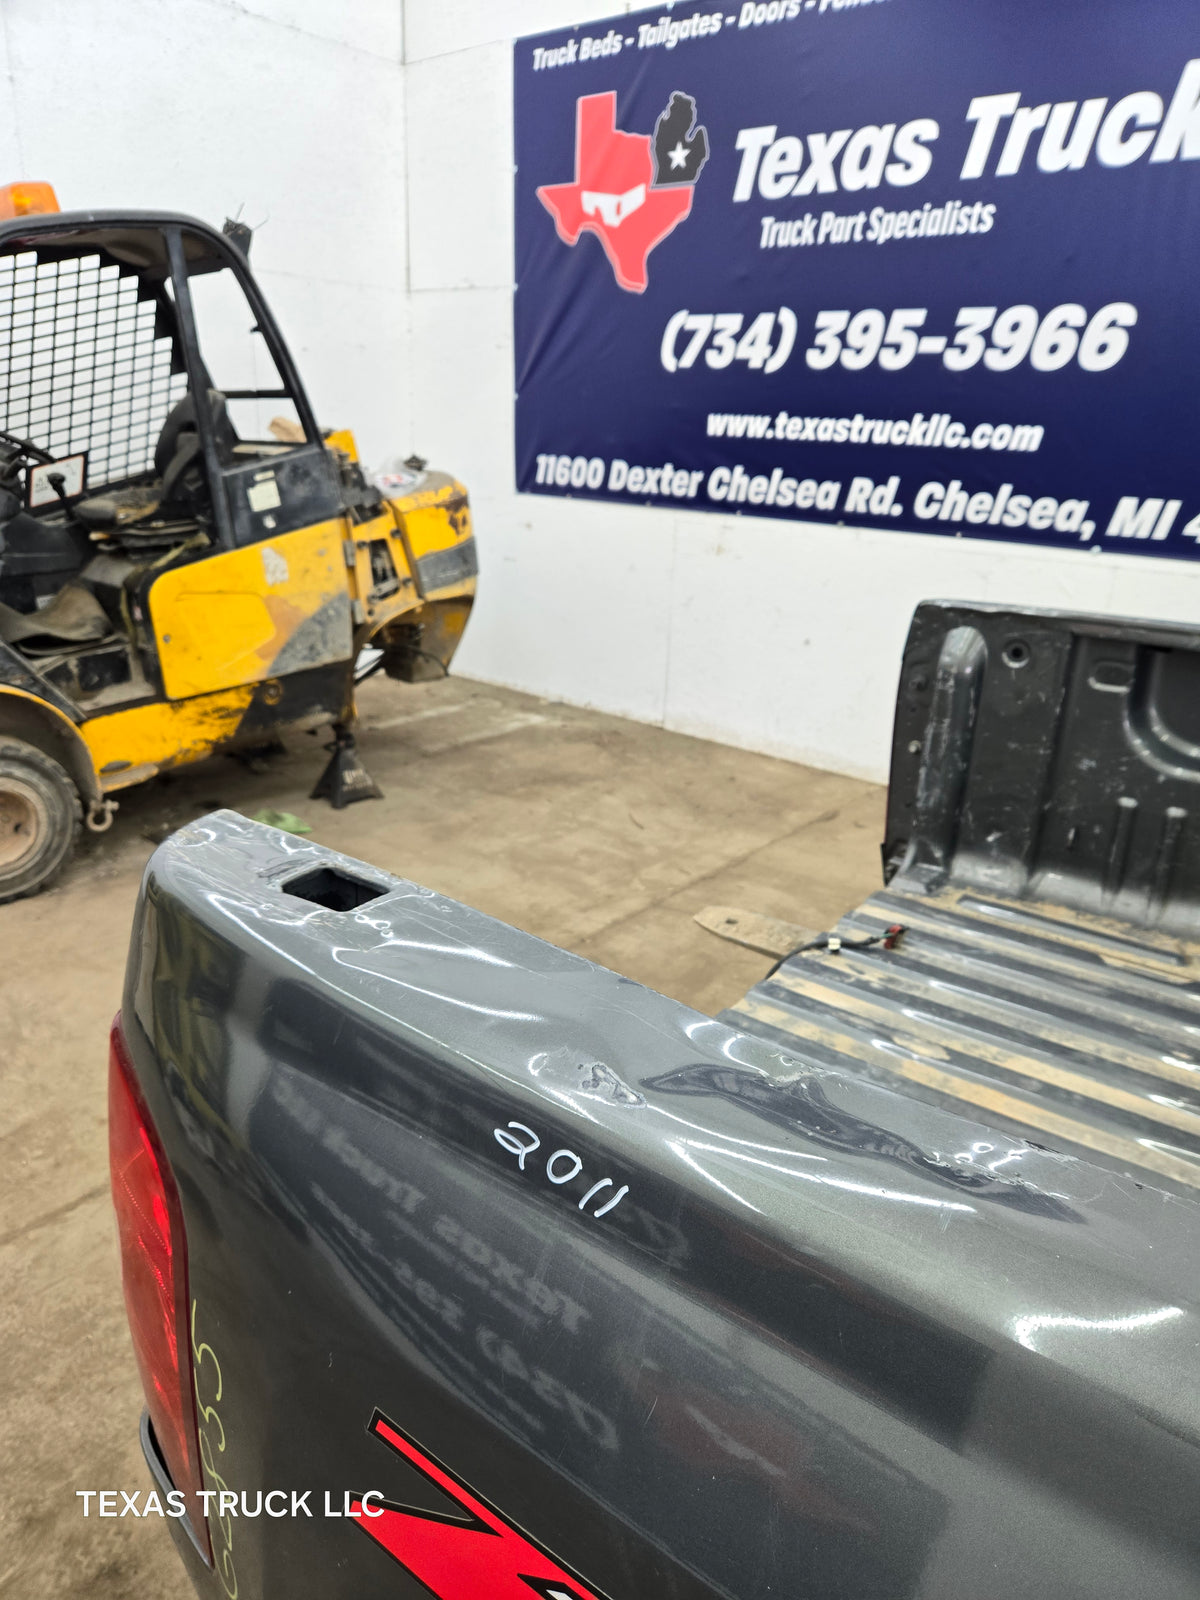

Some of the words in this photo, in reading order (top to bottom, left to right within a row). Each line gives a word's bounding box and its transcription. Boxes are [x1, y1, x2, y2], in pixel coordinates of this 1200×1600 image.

[533, 39, 578, 71] Truck
[578, 30, 623, 61] Beds
[637, 12, 723, 50] Tailgates
[738, 0, 800, 30] Doors
[733, 118, 939, 203] Texas
[760, 214, 815, 249] Truck
[816, 210, 867, 244] Part
[866, 200, 996, 245] Specialists
[660, 306, 798, 374] (734)
[806, 302, 1138, 372] 395-3966
[707, 411, 1044, 452] www.texastruckllc.com
[535, 454, 605, 489] 11600
[608, 459, 704, 497] Dexter
[707, 465, 841, 510] Chelsea
[844, 475, 904, 517] Rd.
[913, 479, 1096, 541] Chelsea,
[1104, 496, 1183, 540] MI
[494, 1121, 630, 1218] 2011
